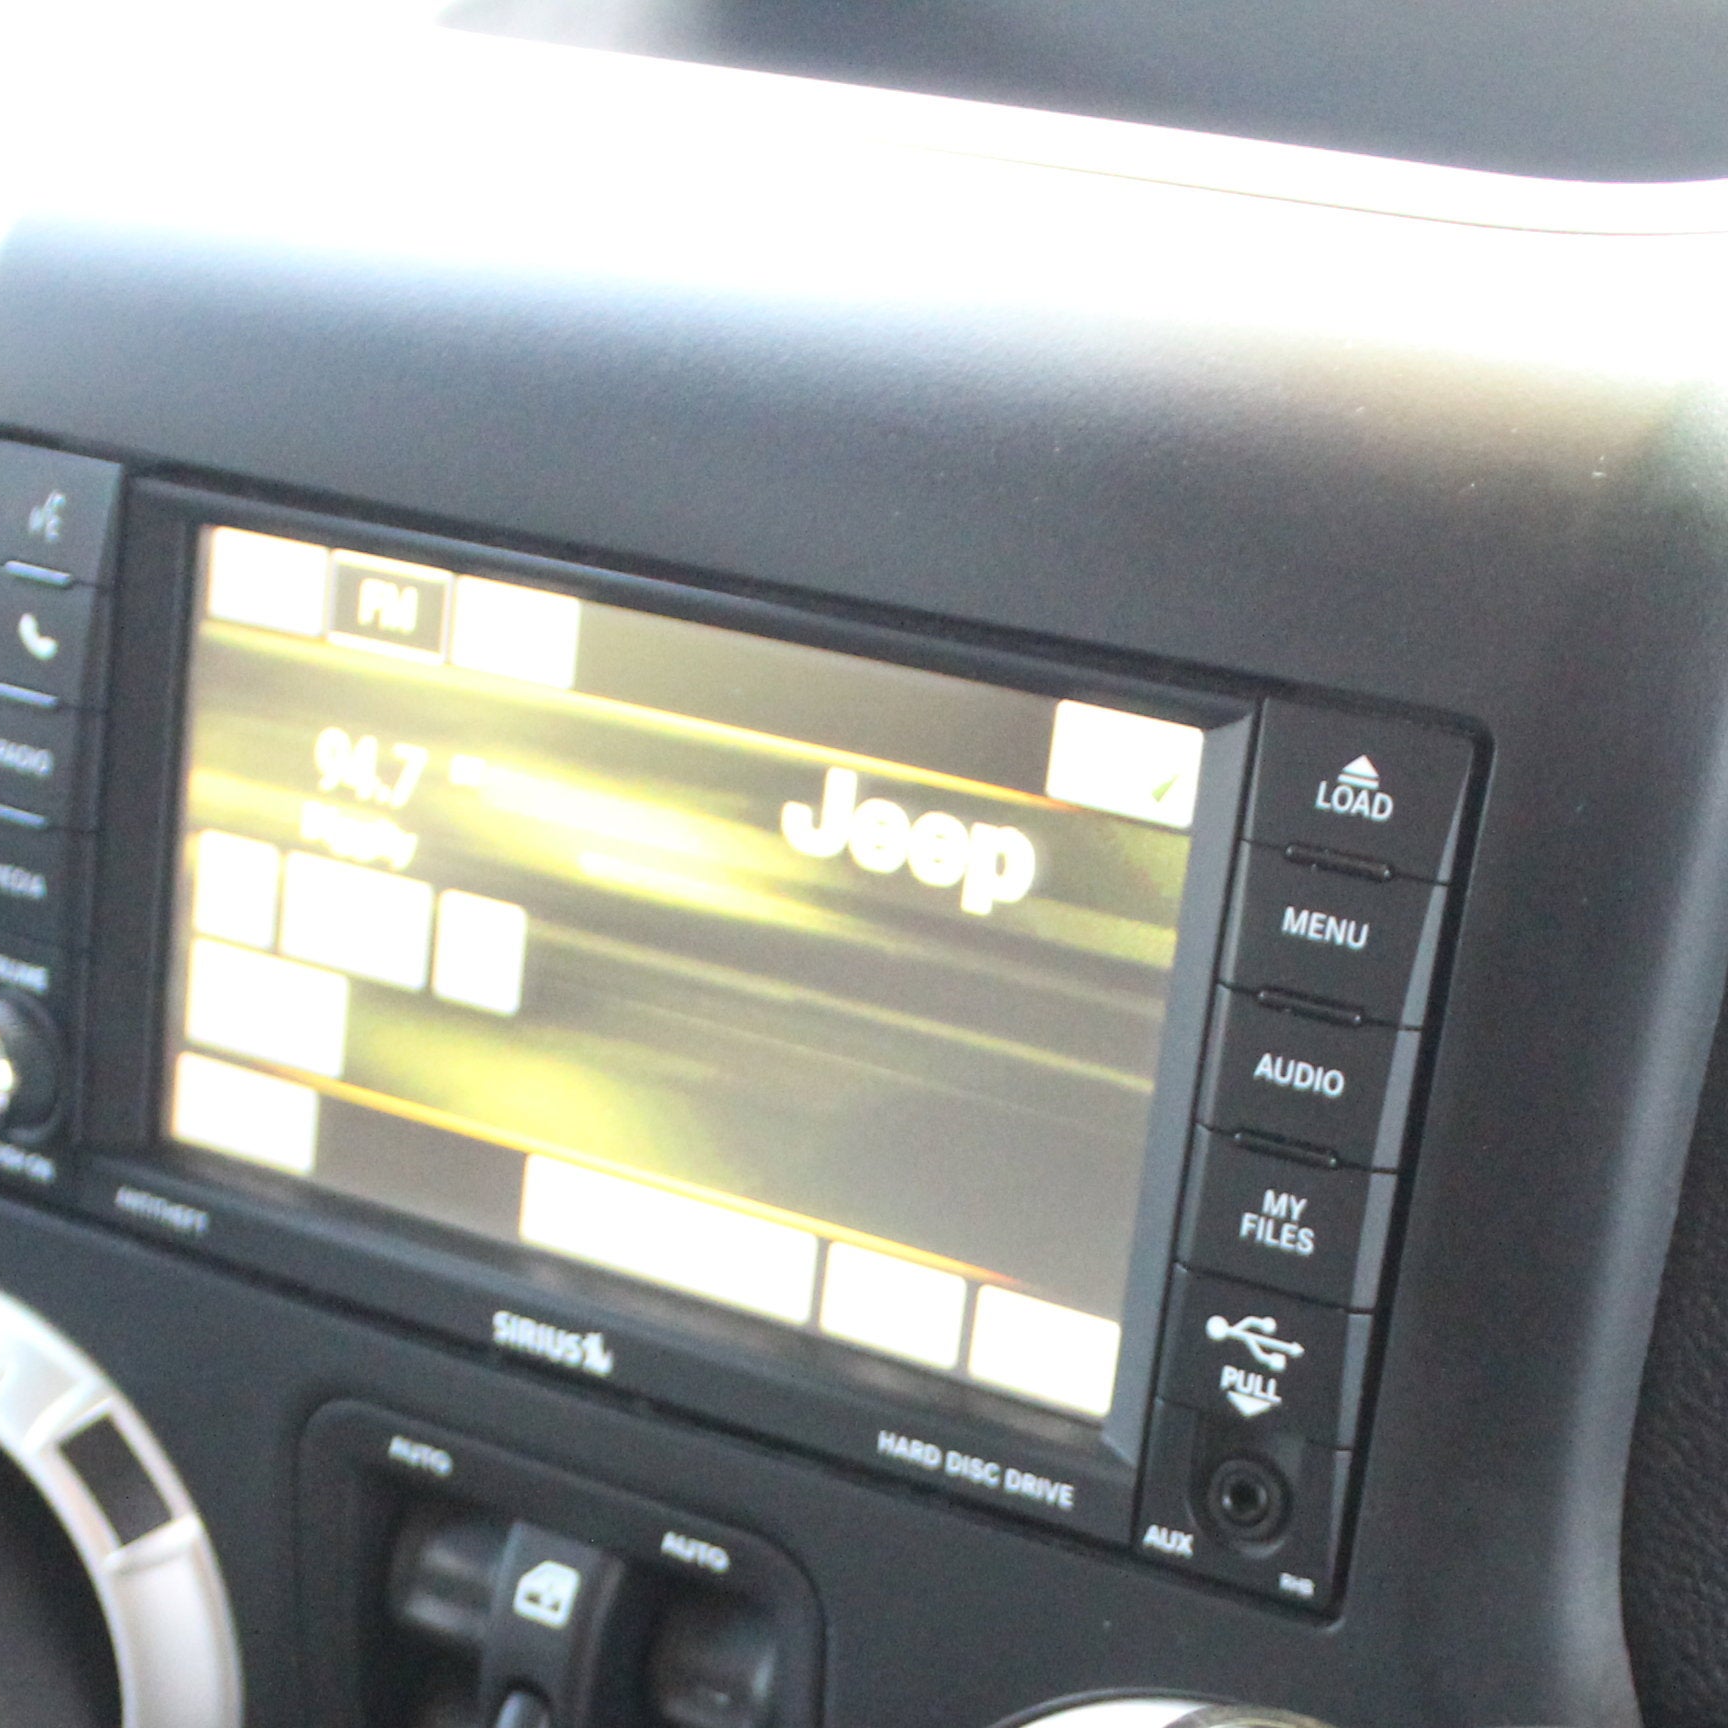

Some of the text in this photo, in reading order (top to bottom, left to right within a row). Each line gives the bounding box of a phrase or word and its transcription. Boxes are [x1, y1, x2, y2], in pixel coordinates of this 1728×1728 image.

[358, 577, 419, 636] FM
[314, 726, 428, 808] 94.7
[1315, 781, 1393, 822] LOAD
[781, 766, 1036, 916] Jeep
[1282, 906, 1370, 950] MENU
[1253, 1053, 1345, 1098] AUDIO
[1263, 1189, 1308, 1221] MY
[1239, 1212, 1315, 1257] FILES
[492, 1310, 583, 1367] SIRIUS
[1220, 1364, 1282, 1404] PULL
[388, 1436, 453, 1478] AUTO
[877, 1429, 1075, 1510] HARD DISC DRIVE
[661, 1531, 731, 1573] AUTO
[1142, 1523, 1194, 1559] AUX
